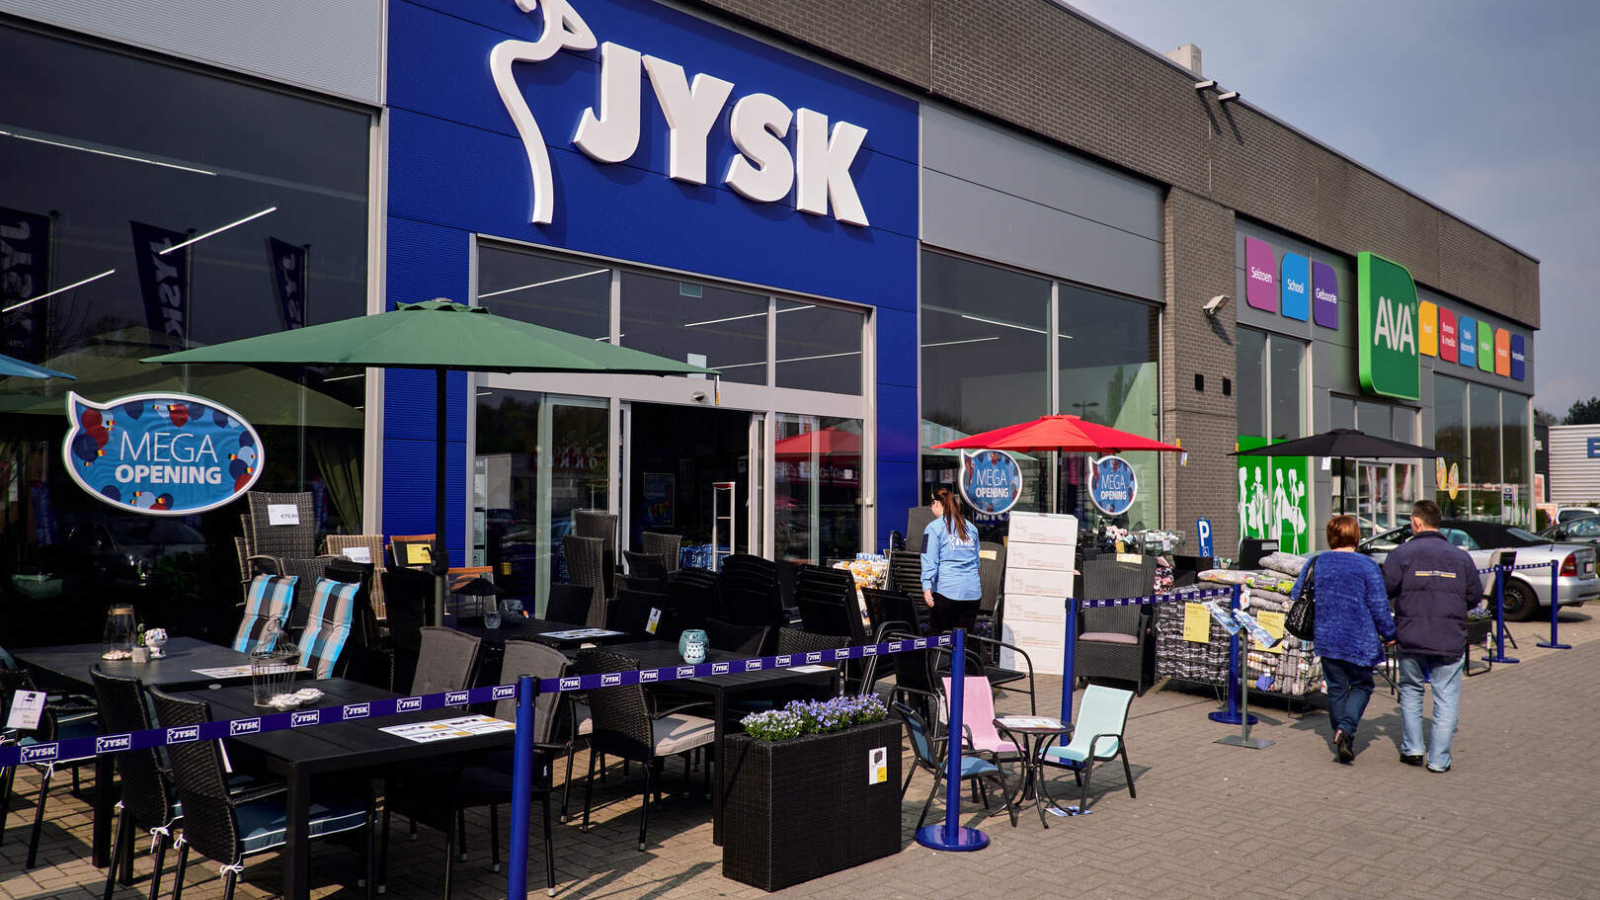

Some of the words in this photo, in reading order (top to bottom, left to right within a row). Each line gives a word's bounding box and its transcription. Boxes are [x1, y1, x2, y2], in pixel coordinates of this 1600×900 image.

[573, 41, 869, 227] JYSK
[1251, 266, 1272, 283] Seizoen
[1287, 278, 1304, 294] School
[1316, 287, 1337, 304] Geboorte
[1374, 296, 1415, 356] AVA
[120, 431, 218, 463] MEGA
[115, 464, 222, 484] OPENING
[976, 469, 1008, 486] MEGA
[1101, 474, 1126, 490] MEGA
[975, 487, 1009, 498] OPENING
[1100, 490, 1127, 500] OPENING
[1199, 520, 1210, 547] P
[28, 747, 55, 758] JYSK
[103, 738, 129, 748] JYSK
[173, 730, 197, 739] JYSK
[236, 721, 259, 731] JYSK
[297, 713, 318, 723] JYSK
[348, 707, 368, 715] JYSK
[497, 688, 514, 696] JYSK
